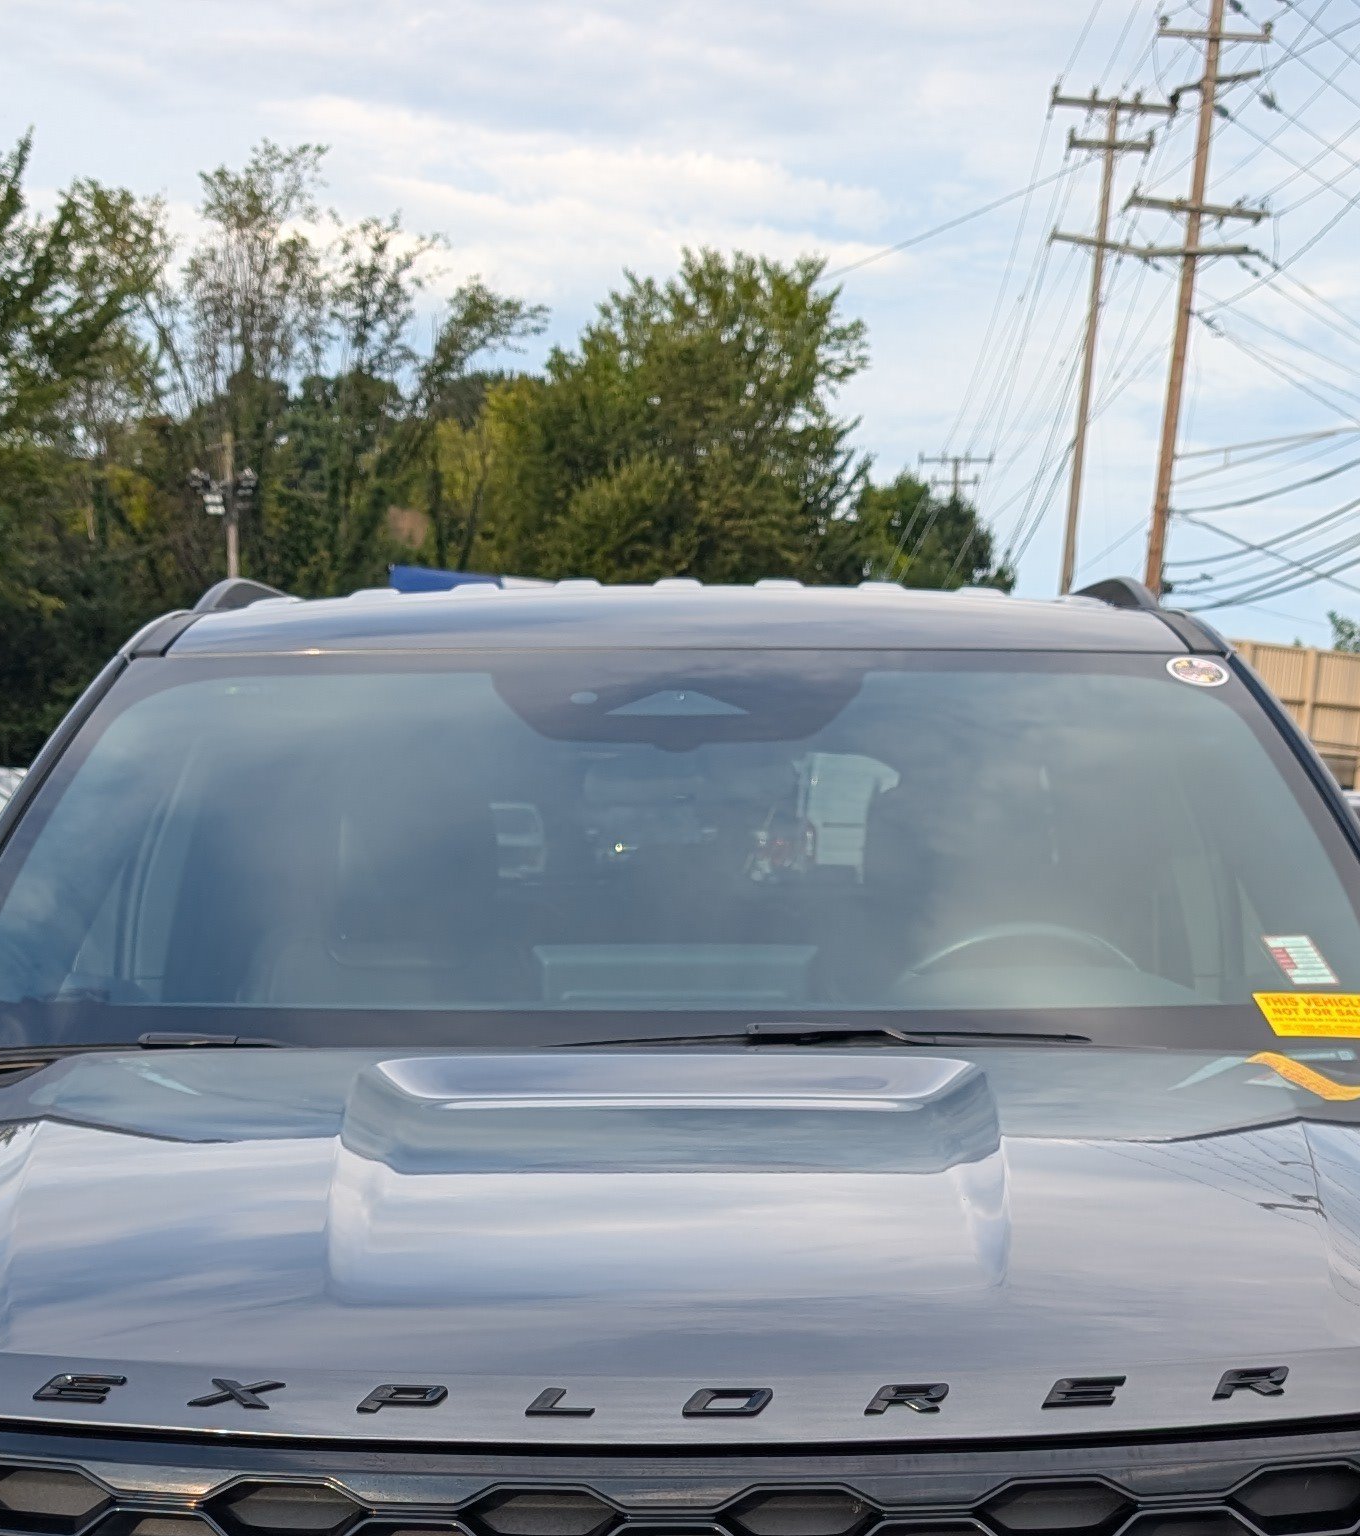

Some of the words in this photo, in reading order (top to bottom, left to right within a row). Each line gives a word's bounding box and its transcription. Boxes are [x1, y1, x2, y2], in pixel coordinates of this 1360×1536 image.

[1261, 997, 1300, 1007] THIS
[1272, 1008, 1299, 1016] NOT
[1303, 1008, 1331, 1017] FOR
[32, 1366, 1290, 1419] EXPLORER
